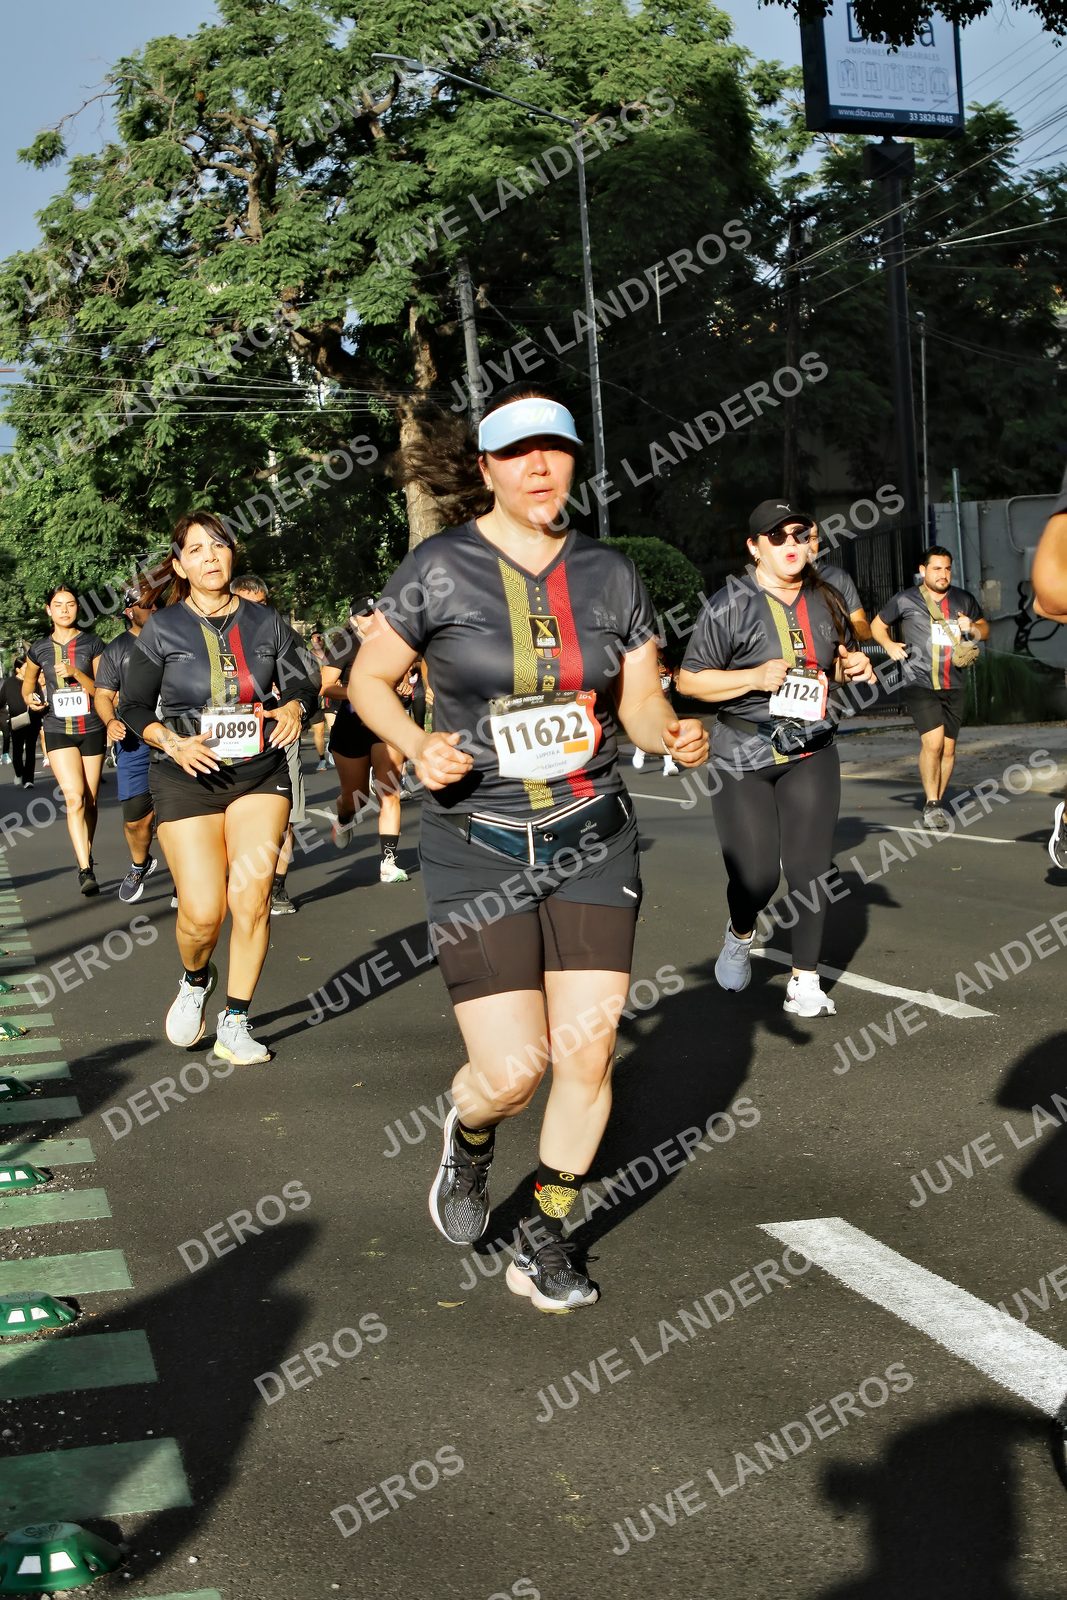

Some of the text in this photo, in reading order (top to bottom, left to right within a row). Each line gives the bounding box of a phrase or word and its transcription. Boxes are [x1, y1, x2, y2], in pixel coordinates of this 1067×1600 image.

[838, 108, 895, 119] www.dibra.com.mx
[909, 112, 954, 124] 33 3826 4845
[775, 682, 819, 702] 1124
[58, 696, 82, 707] 9710
[499, 711, 587, 754] 11622
